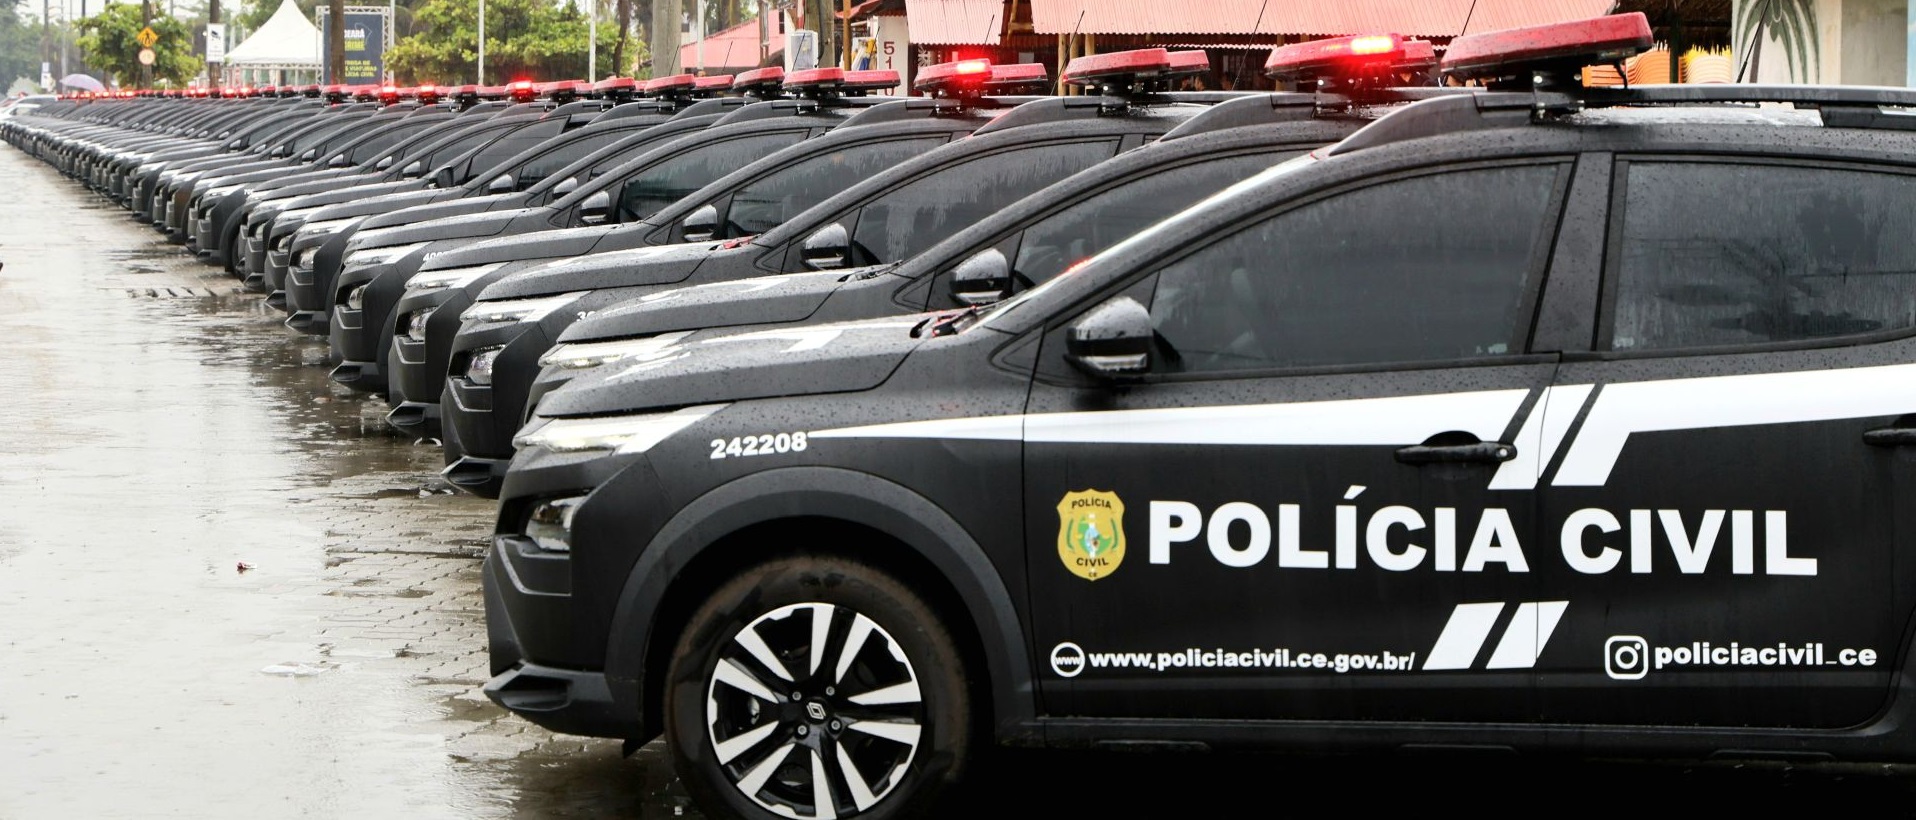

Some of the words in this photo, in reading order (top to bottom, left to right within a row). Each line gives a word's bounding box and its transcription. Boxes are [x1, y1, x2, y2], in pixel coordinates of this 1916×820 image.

[710, 431, 808, 460] 242208
[1071, 497, 1112, 509] POLÍCIA
[1148, 485, 1530, 573] POLÍCIA
[1560, 508, 1818, 576] CIVIL
[1076, 557, 1109, 567] CIVIL
[1089, 648, 1415, 673] www.policiacivil.ce.gov.br/
[1655, 642, 1877, 669] policiacivil_ce
